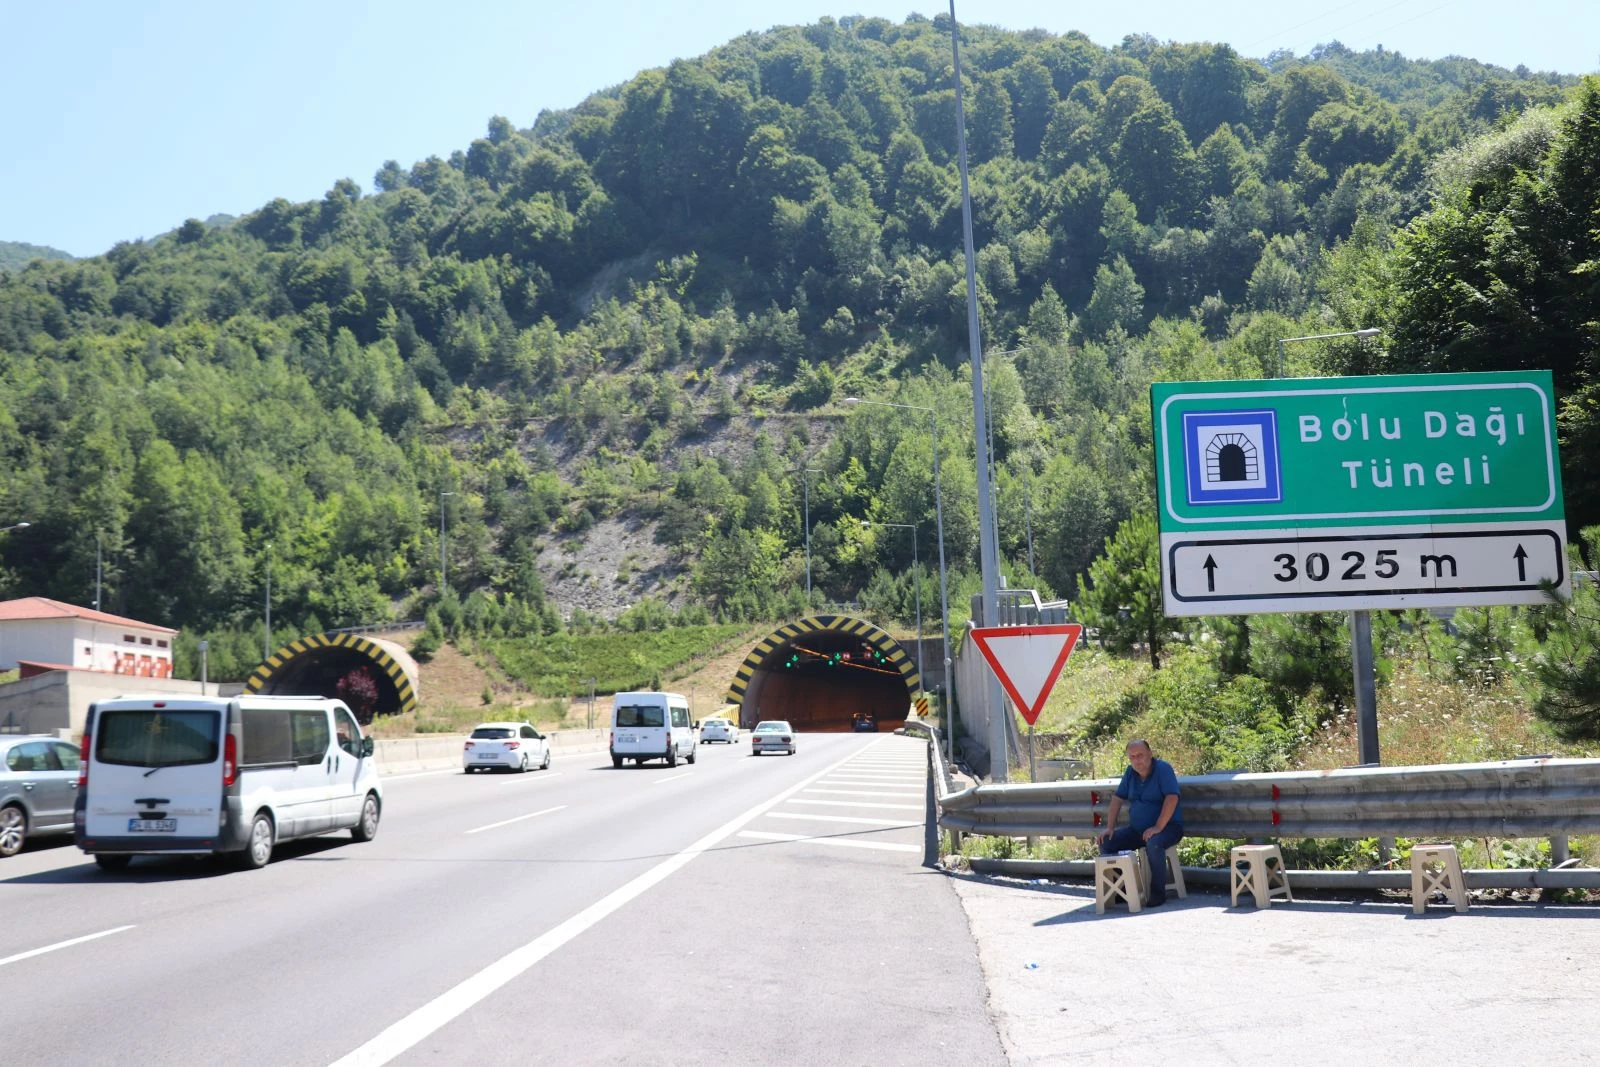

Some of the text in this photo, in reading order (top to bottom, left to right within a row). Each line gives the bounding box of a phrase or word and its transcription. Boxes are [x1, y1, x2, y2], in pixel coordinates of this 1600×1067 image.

[1298, 406, 1525, 446] Bolu Dağı
[1342, 455, 1491, 489] Tüneli
[1273, 550, 1457, 582] 3025 m
